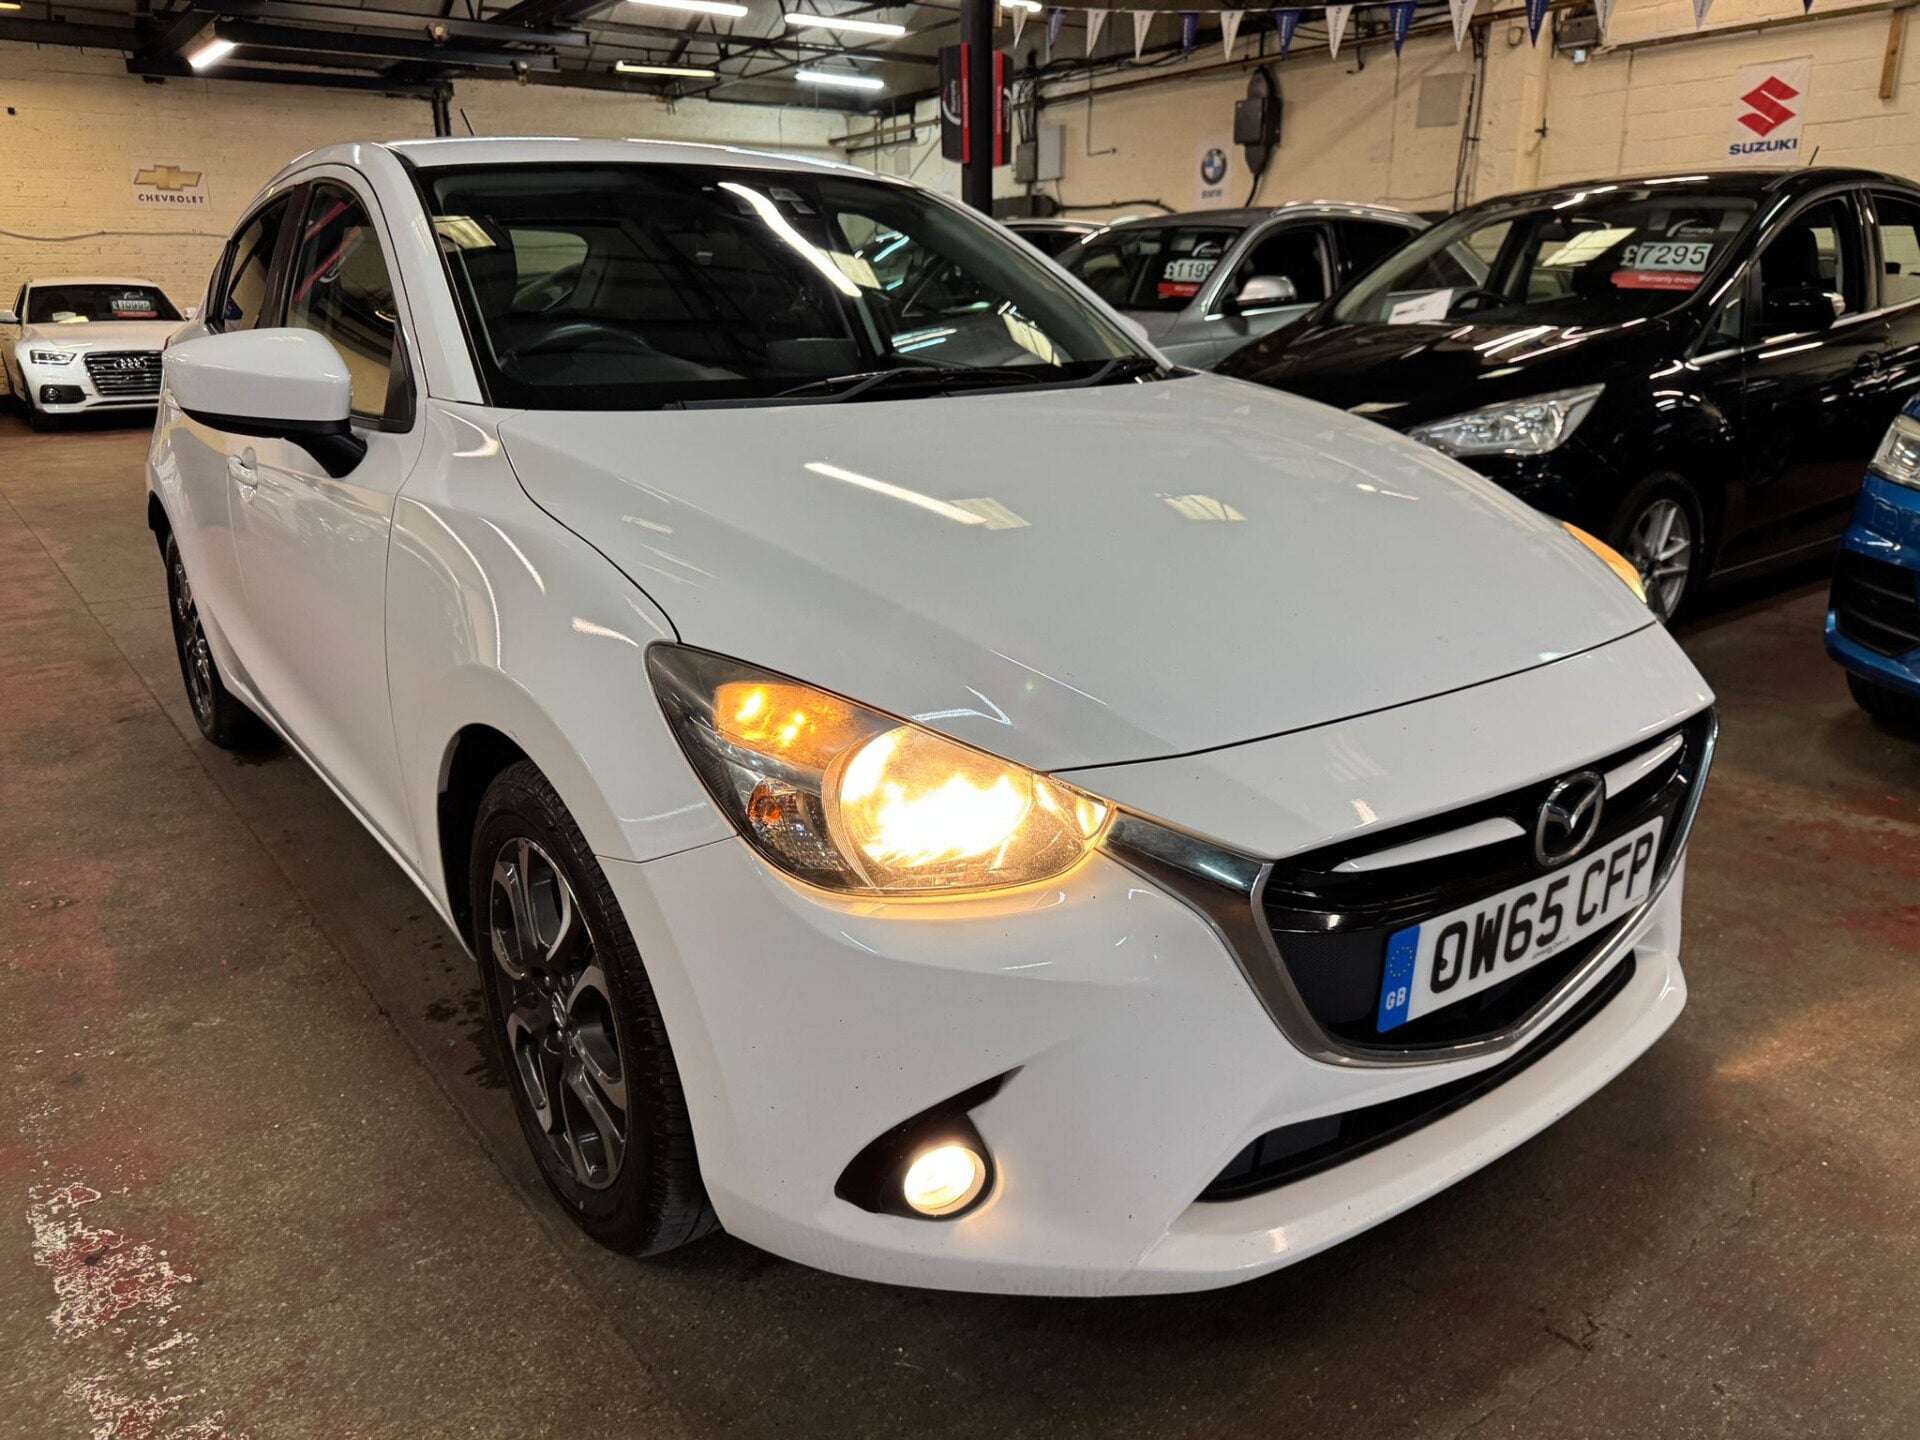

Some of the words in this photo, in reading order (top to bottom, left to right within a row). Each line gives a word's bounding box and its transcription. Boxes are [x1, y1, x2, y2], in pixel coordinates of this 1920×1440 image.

[1729, 138, 1798, 155] SUZUKI
[138, 194, 204, 203] CHEVROLET
[1620, 245, 1708, 266] £7295
[1430, 875, 1570, 993] OW65
[1576, 831, 1654, 926] CFP
[1386, 986, 1407, 1010] GB
